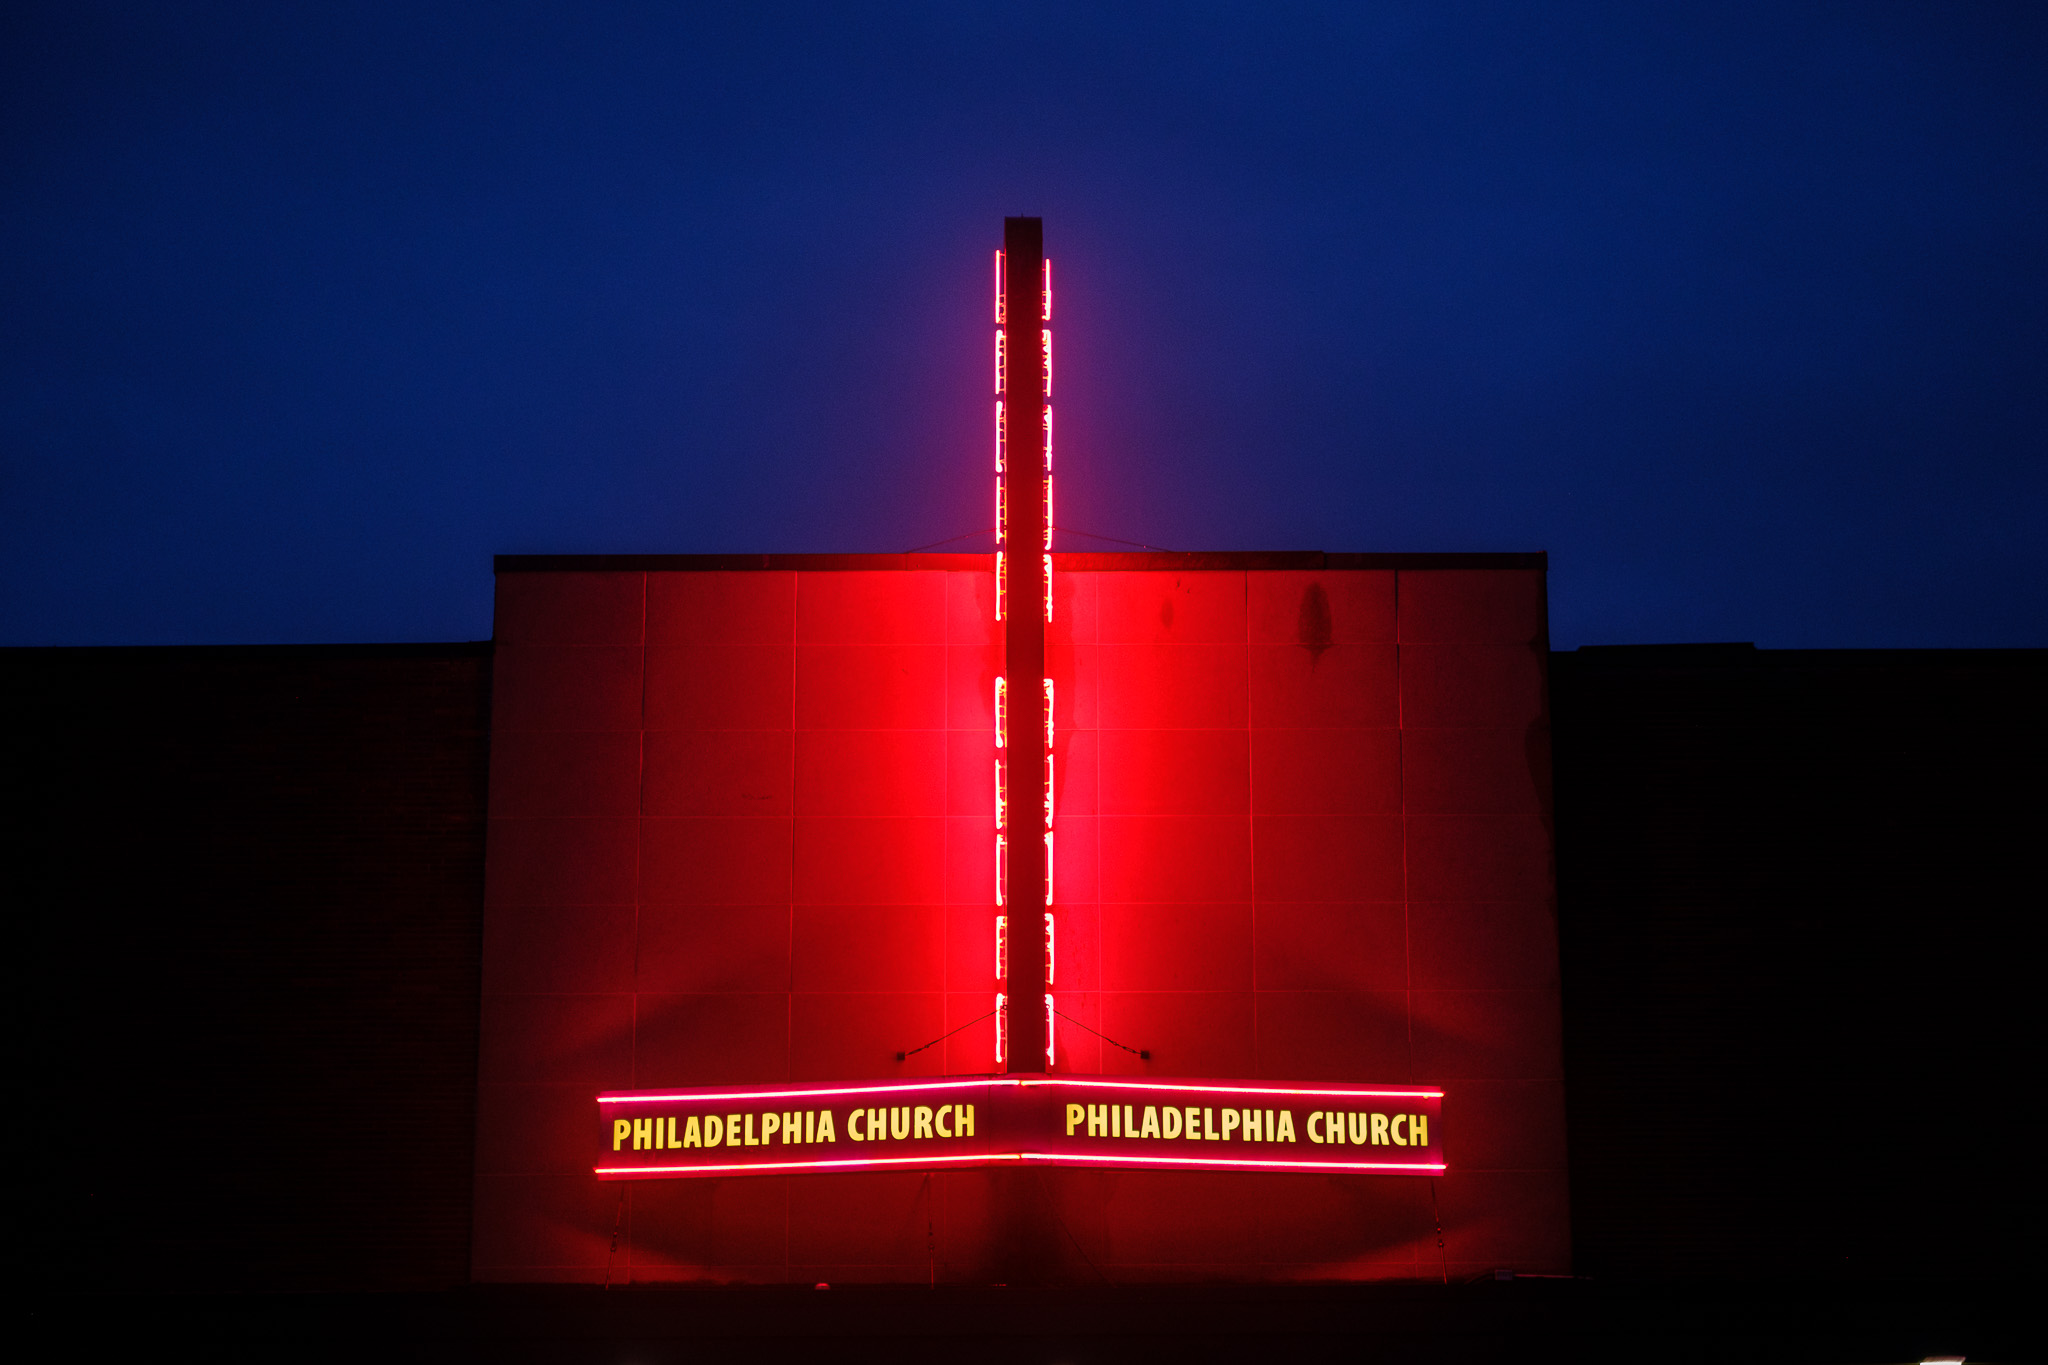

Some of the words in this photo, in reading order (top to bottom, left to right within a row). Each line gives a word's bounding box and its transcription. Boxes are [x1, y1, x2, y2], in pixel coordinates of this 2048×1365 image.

[613, 1110, 836, 1151] PHILADELPHIA
[847, 1104, 975, 1142] CHURCH
[1066, 1103, 1297, 1143] PHILADELPHIA
[1306, 1111, 1429, 1147] CHURCH
